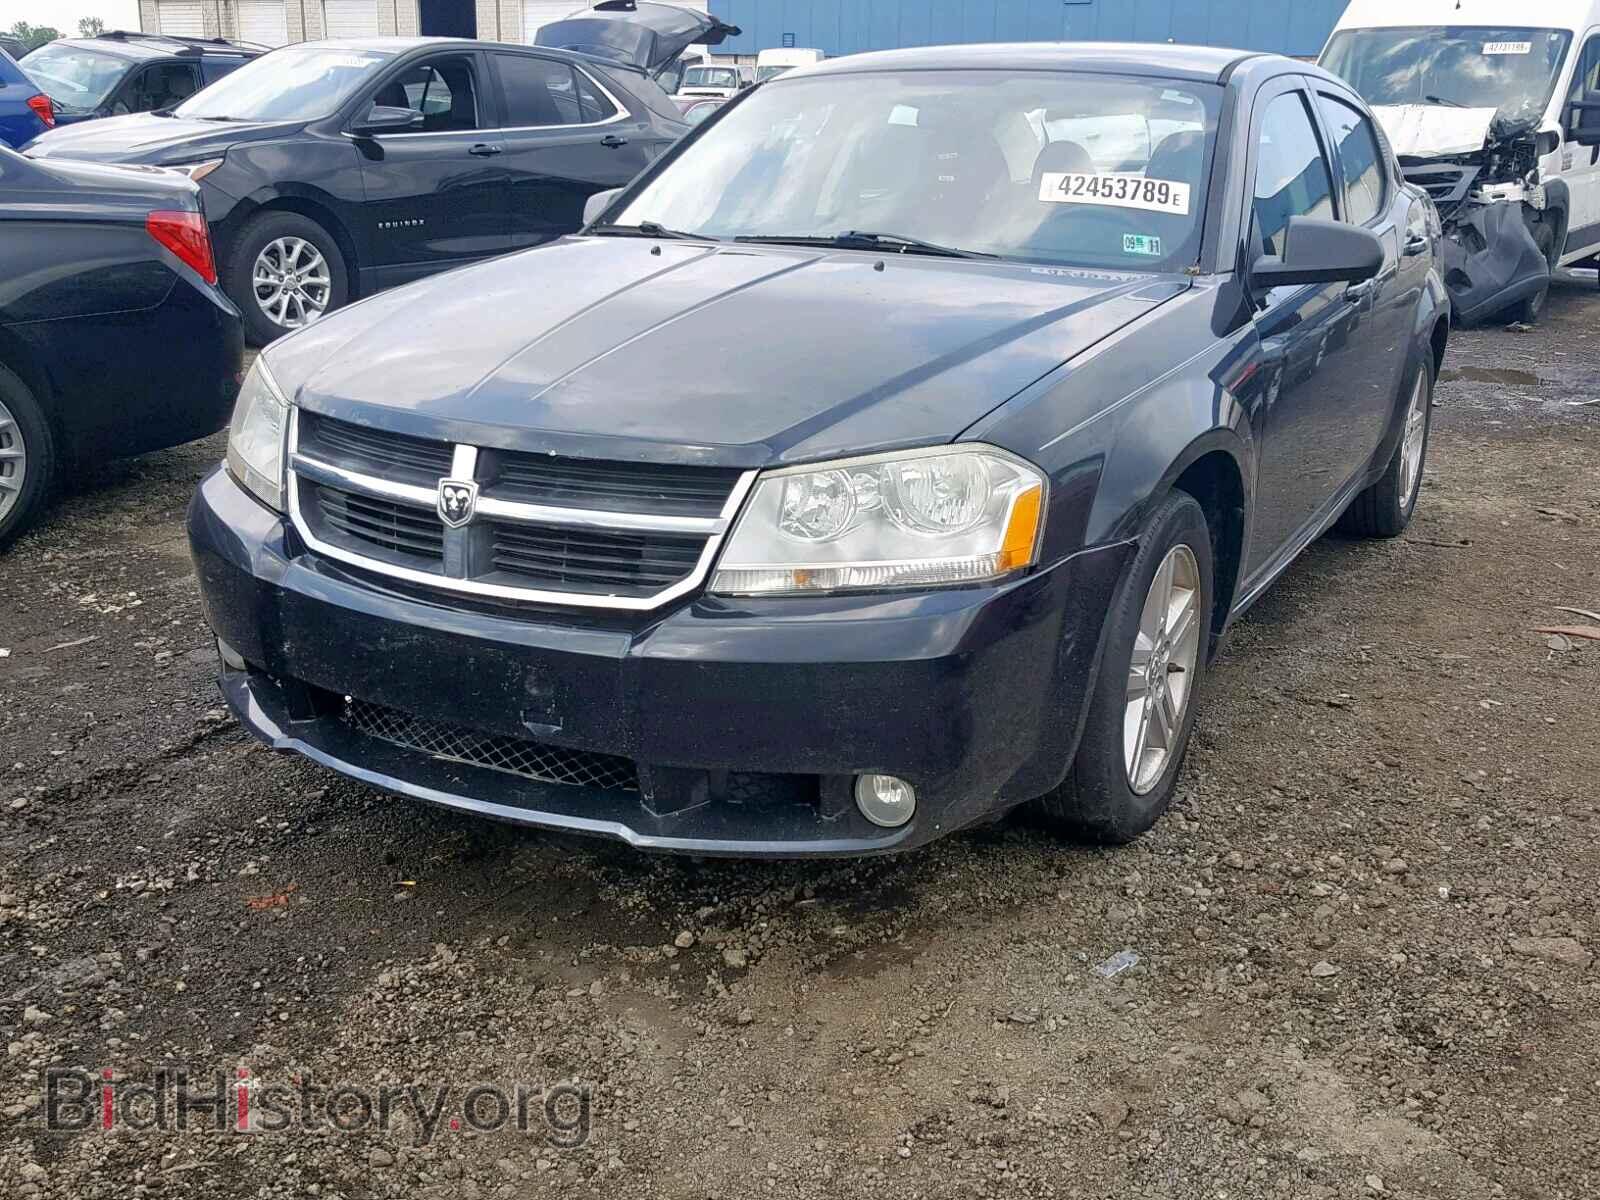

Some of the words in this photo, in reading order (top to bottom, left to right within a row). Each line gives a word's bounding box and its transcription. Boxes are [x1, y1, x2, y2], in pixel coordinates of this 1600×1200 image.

[1058, 174, 1171, 205] 42453789
[1172, 193, 1181, 206] E
[378, 219, 425, 229] EQUINOX
[1123, 236, 1135, 249] 09
[1149, 239, 1160, 253] 11
